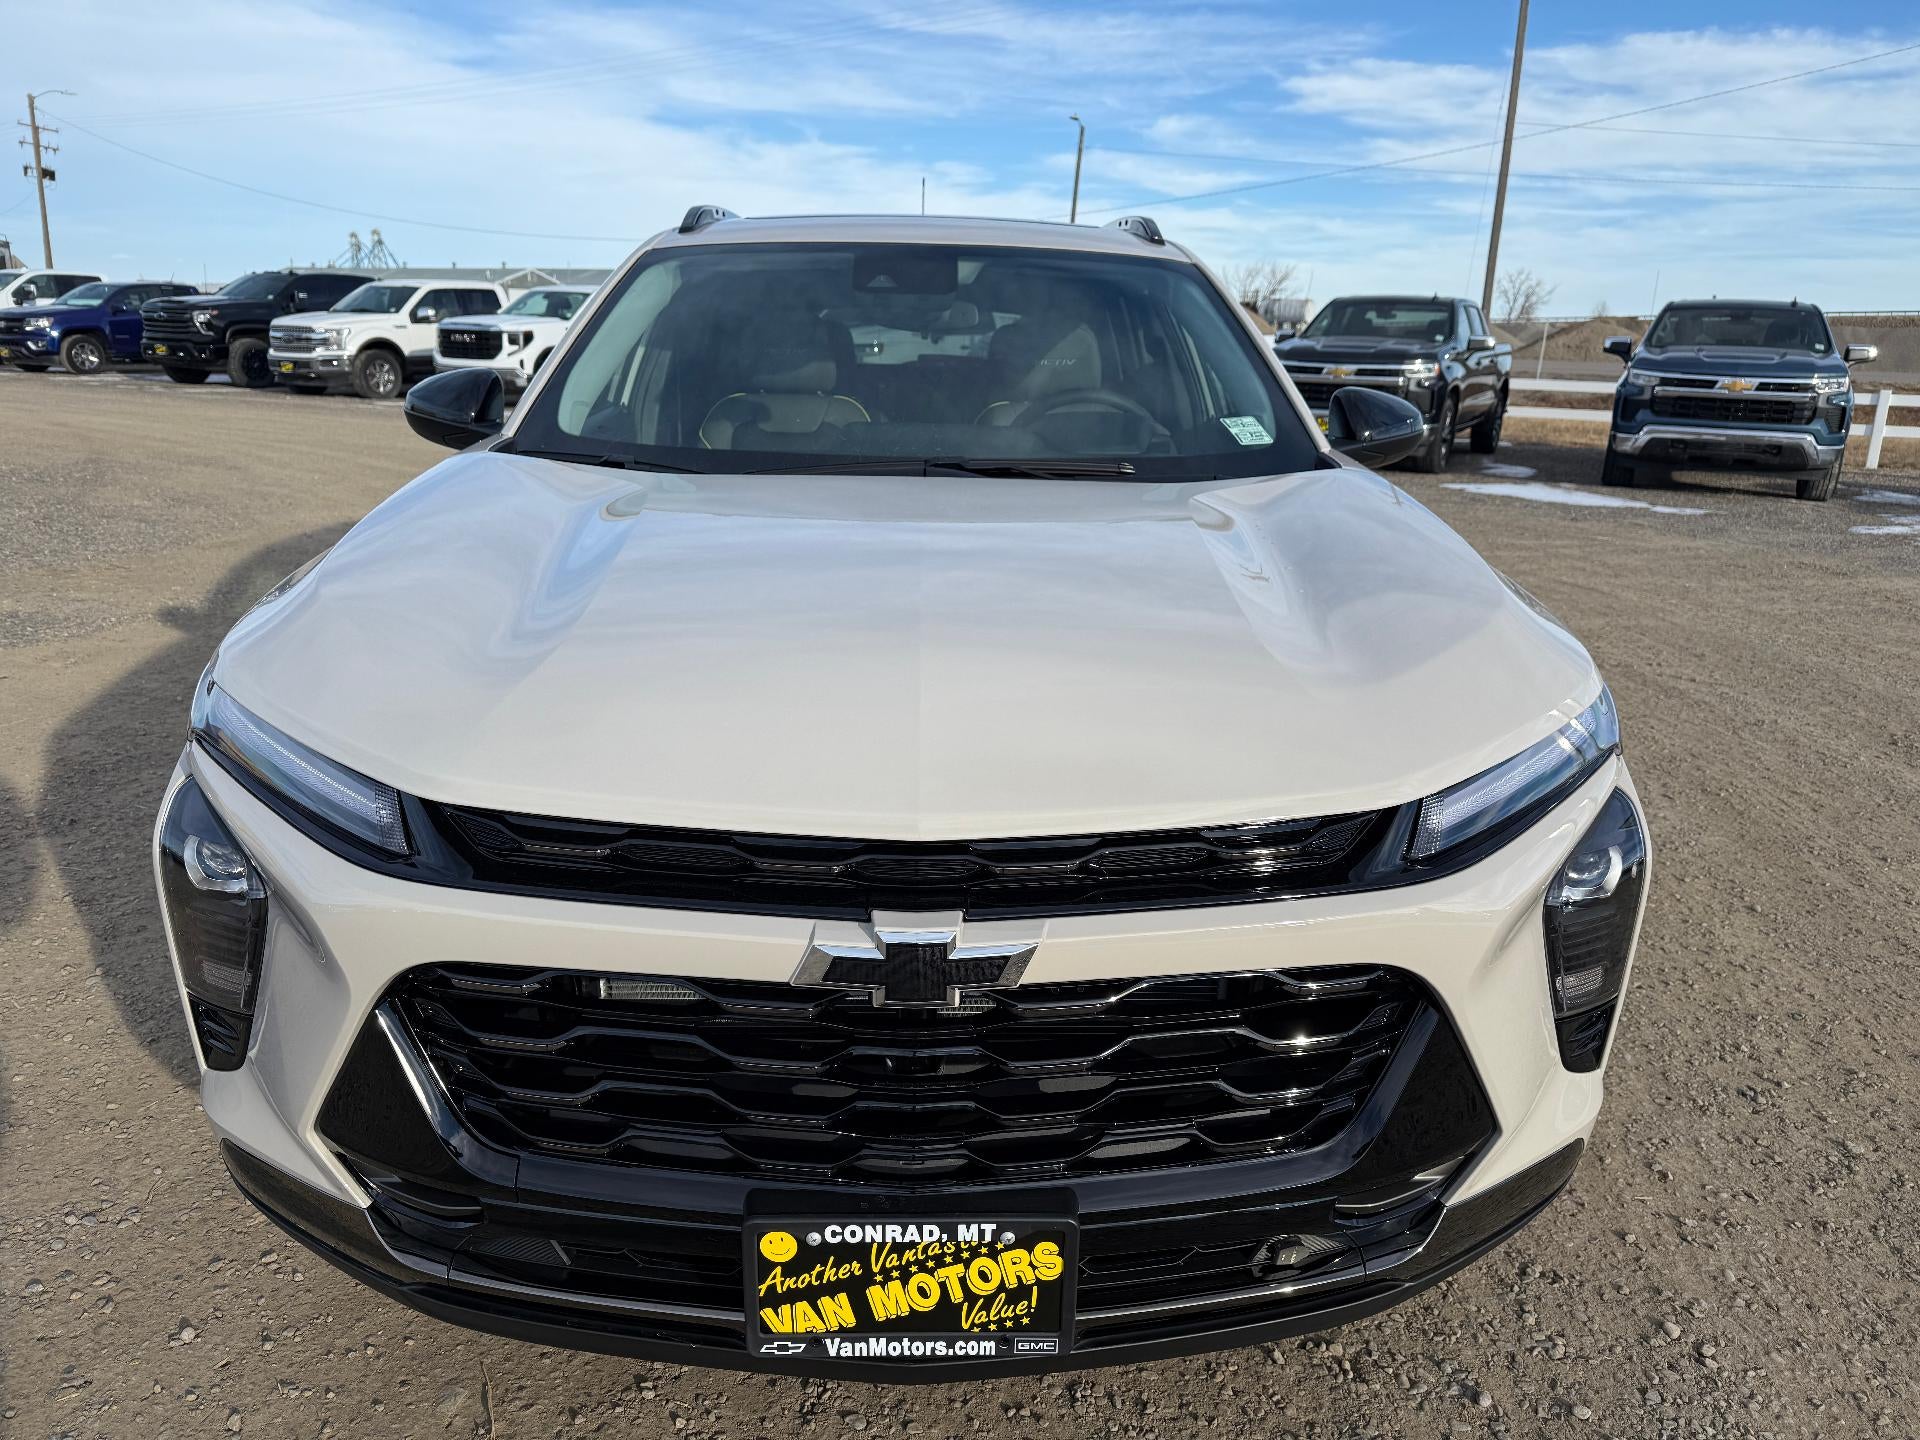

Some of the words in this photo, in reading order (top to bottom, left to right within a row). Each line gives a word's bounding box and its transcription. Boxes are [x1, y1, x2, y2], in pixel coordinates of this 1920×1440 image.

[824, 1224, 948, 1244] CONRAD,
[957, 1223, 997, 1244] MT
[759, 1257, 862, 1297] Another
[870, 1239, 979, 1273] Vantas
[759, 1292, 857, 1334] VAN
[866, 1241, 1064, 1322] MOTORS
[961, 1285, 1038, 1330] Value!
[824, 1337, 996, 1357] VanMotors.com
[1017, 1342, 1055, 1350] GMC
